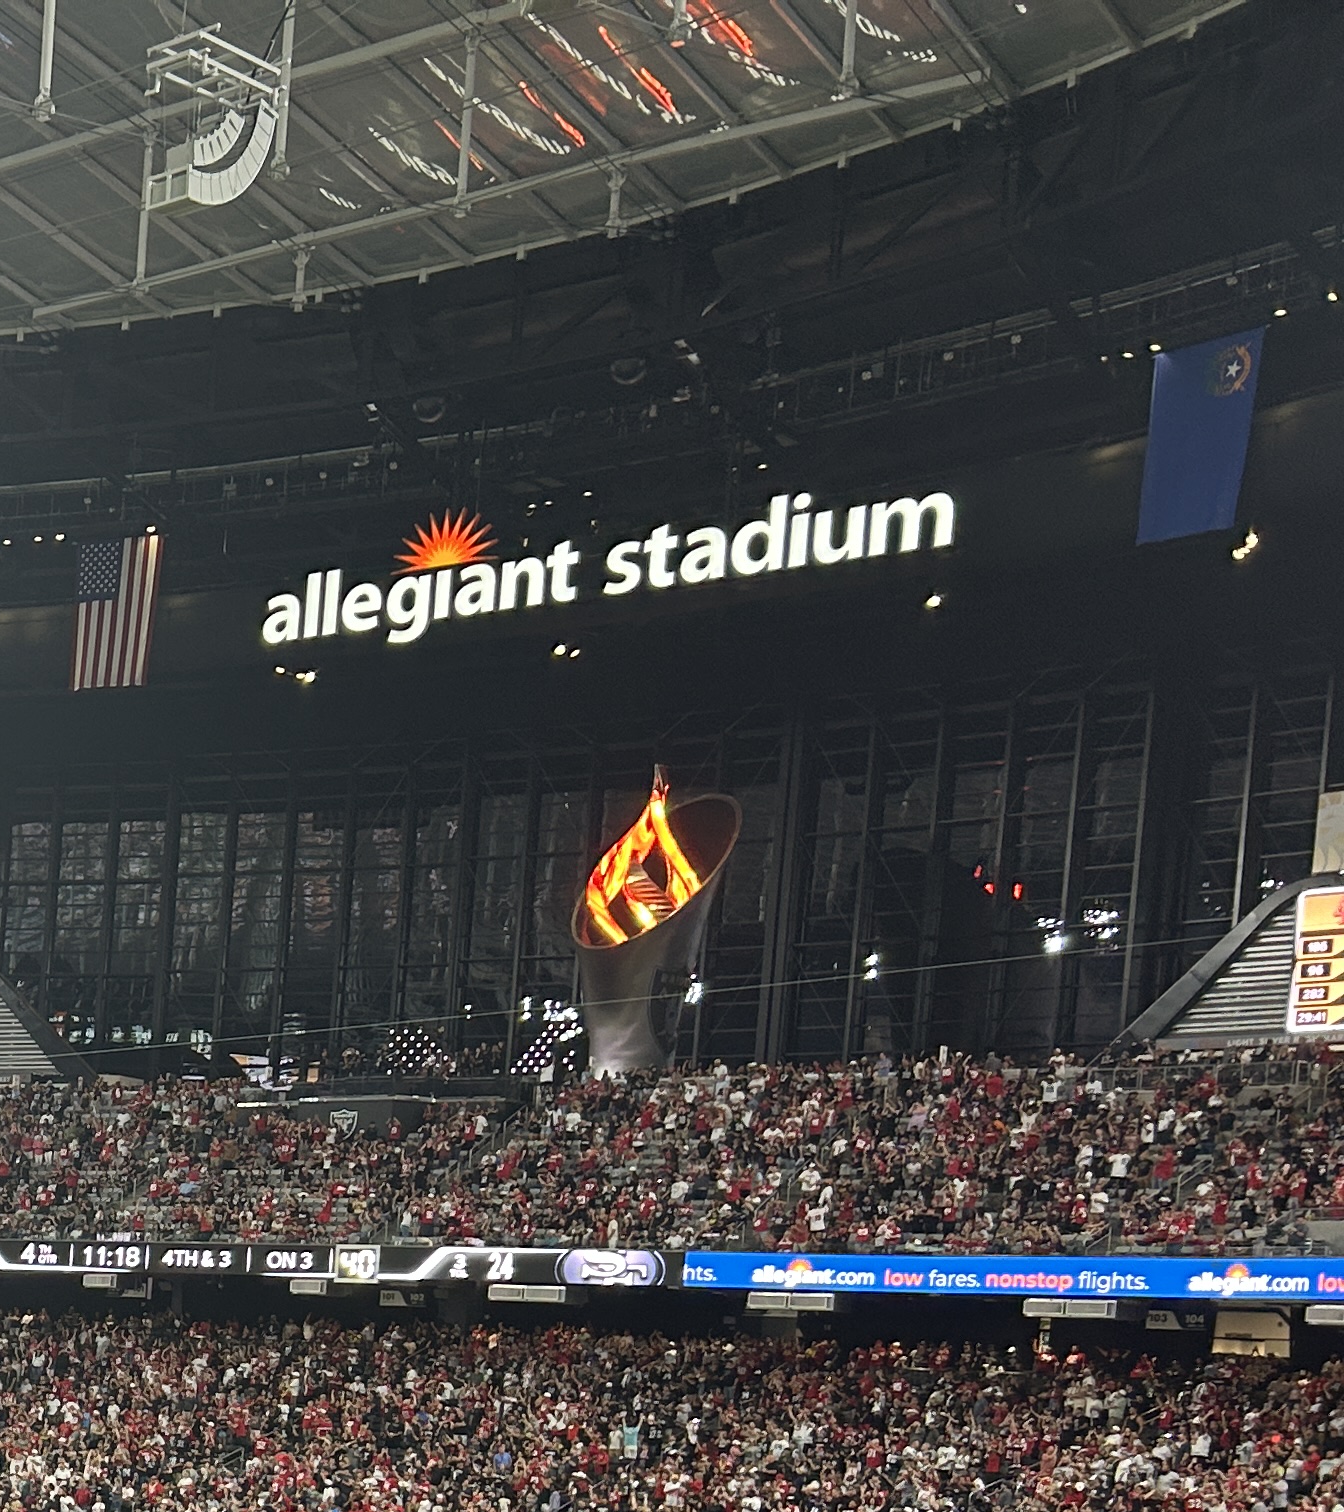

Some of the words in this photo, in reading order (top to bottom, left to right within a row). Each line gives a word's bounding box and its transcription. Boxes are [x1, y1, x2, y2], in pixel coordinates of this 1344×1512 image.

[261, 541, 580, 644] allegiant
[604, 490, 956, 595] stadium
[20, 1242, 35, 1264] 4
[82, 1245, 141, 1267] 11:18
[161, 1249, 199, 1268] 4TH
[200, 1250, 215, 1268] &
[219, 1250, 232, 1268] 3
[267, 1251, 297, 1269] ON
[299, 1251, 313, 1269] 3
[487, 1252, 514, 1280] 24
[751, 1265, 875, 1288] allegiant.com
[883, 1268, 923, 1287] low
[928, 1268, 981, 1288] fares.
[985, 1272, 1074, 1292] nonstop
[1077, 1269, 1150, 1294] flights.
[1187, 1274, 1310, 1296] allegiant.com
